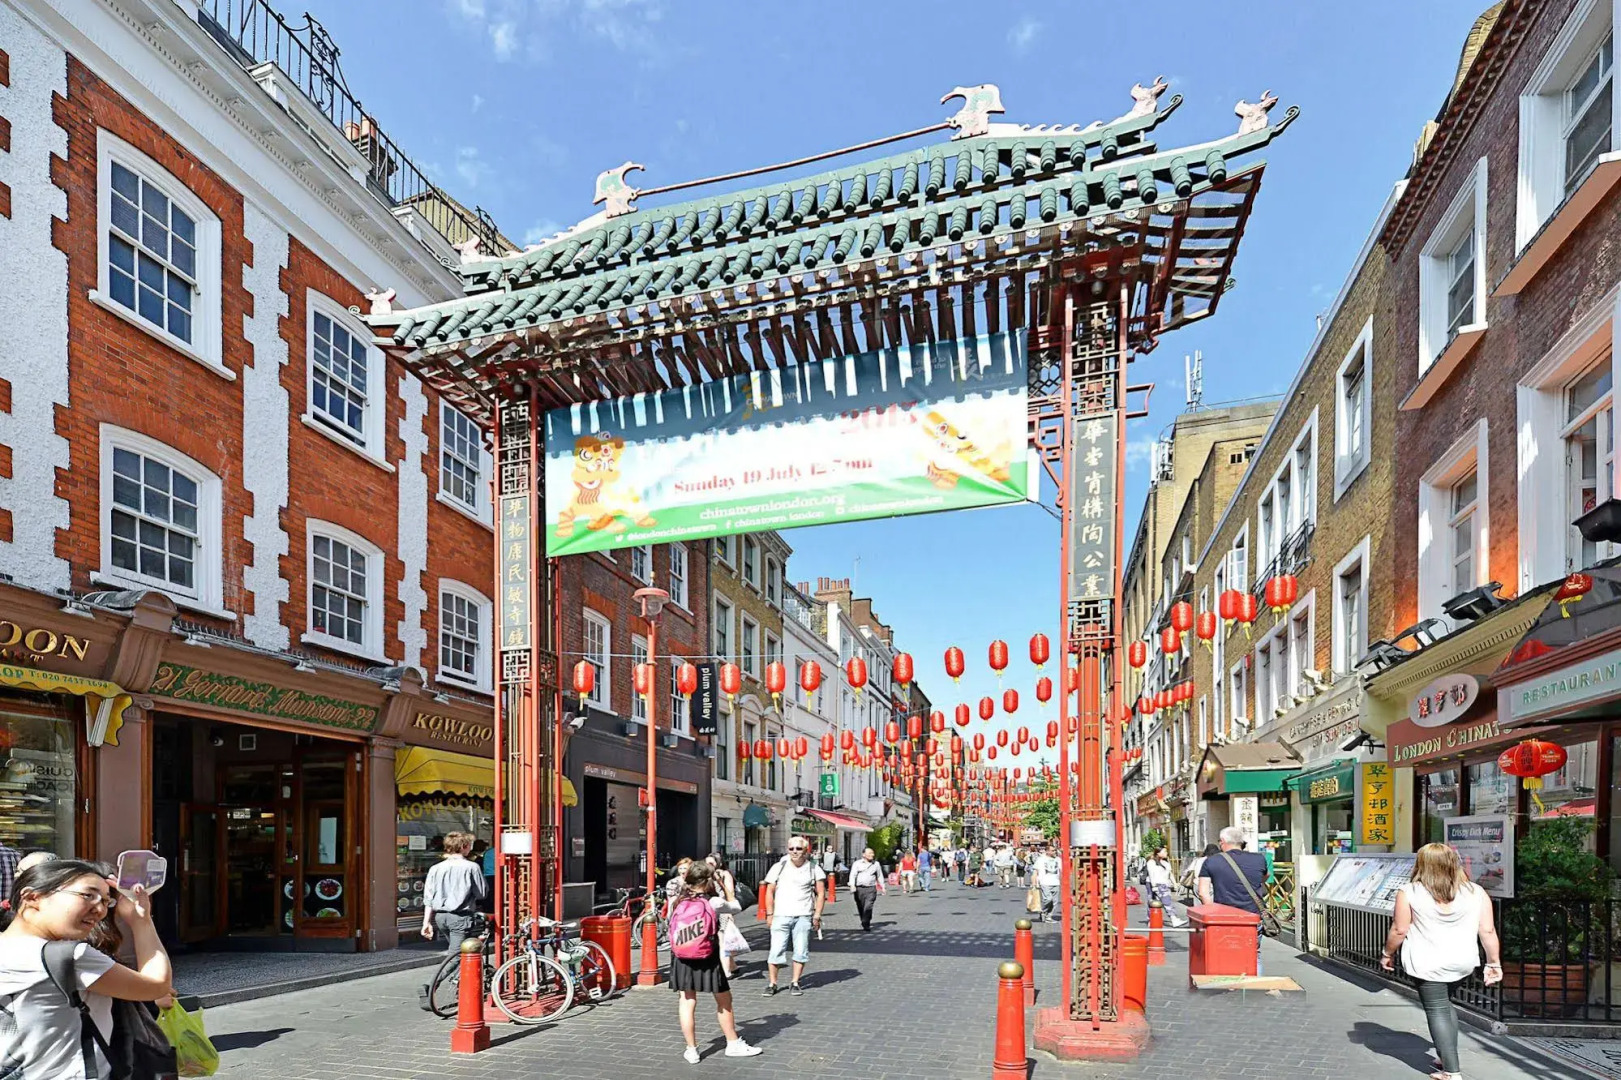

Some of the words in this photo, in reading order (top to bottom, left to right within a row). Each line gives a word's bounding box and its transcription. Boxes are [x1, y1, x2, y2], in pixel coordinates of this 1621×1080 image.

[674, 473, 735, 493] Sunday
[743, 470, 761, 484] 19
[766, 463, 802, 483] July
[42, 673, 60, 681] 020
[152, 666, 181, 691] 21
[174, 670, 274, 708] Gerrard
[701, 667, 712, 690] plum
[701, 691, 713, 720] valley
[413, 712, 494, 741] KOWLOO
[430, 730, 483, 749] RESTAURANT
[584, 765, 599, 774] plum
[601, 768, 616, 778] valley
[1366, 764, 1390, 842] 翠亨邨酒家
[1451, 828, 1469, 838] Crispy
[1482, 826, 1502, 837] Menu
